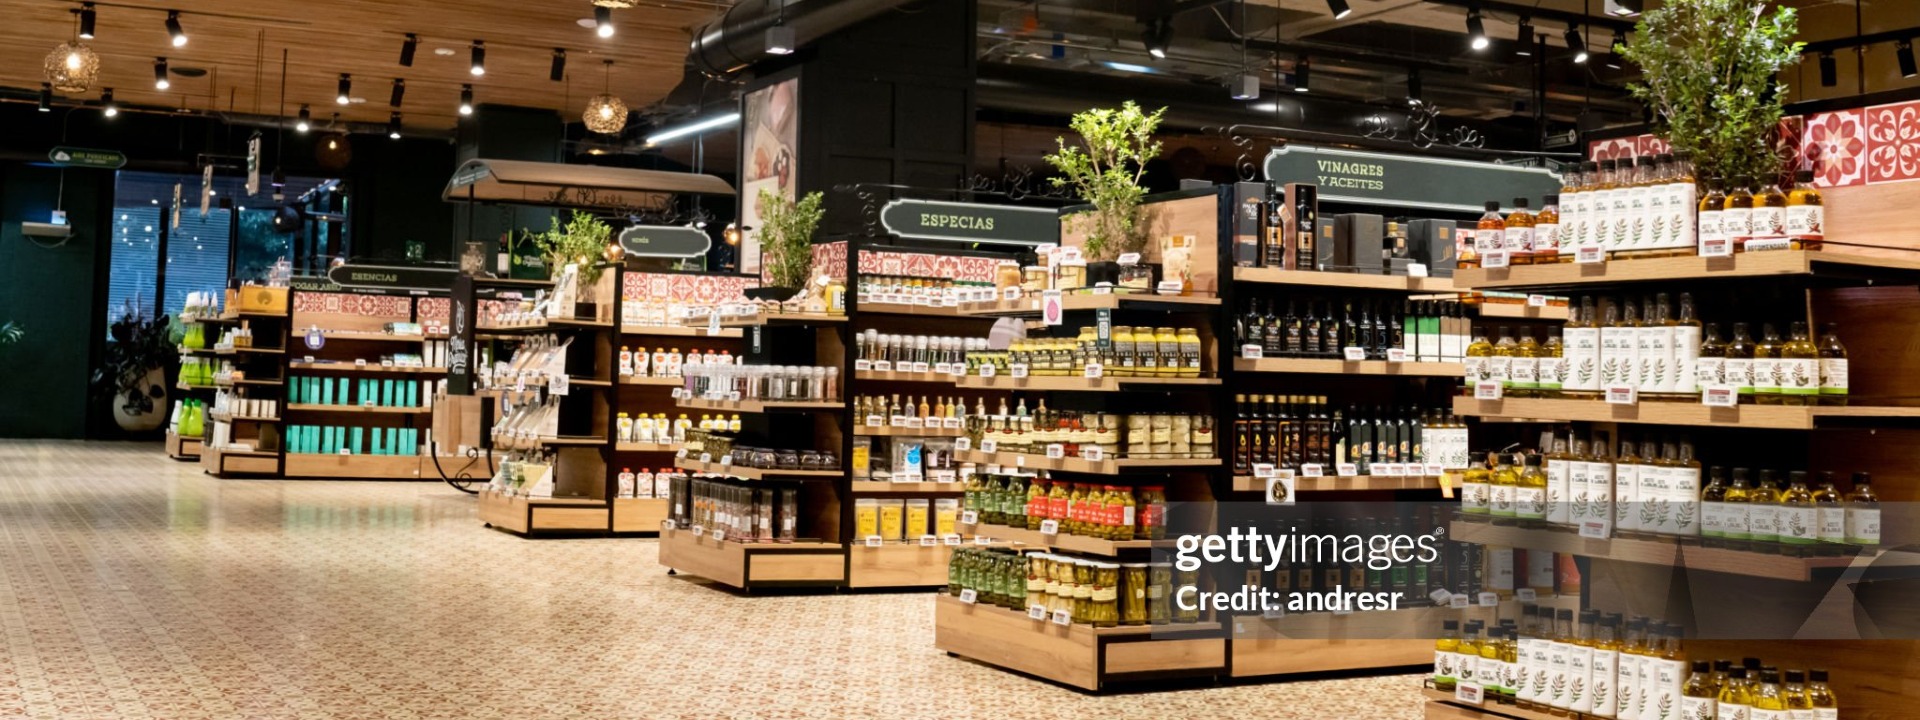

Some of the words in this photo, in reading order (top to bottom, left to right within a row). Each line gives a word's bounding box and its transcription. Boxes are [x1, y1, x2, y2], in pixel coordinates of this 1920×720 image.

[1317, 160, 1384, 176] VINAGRES
[1317, 175, 1328, 186] Y
[1329, 176, 1384, 190] ACEITES
[920, 213, 994, 230] ESPECIAS
[351, 272, 398, 282] ESENCIAS
